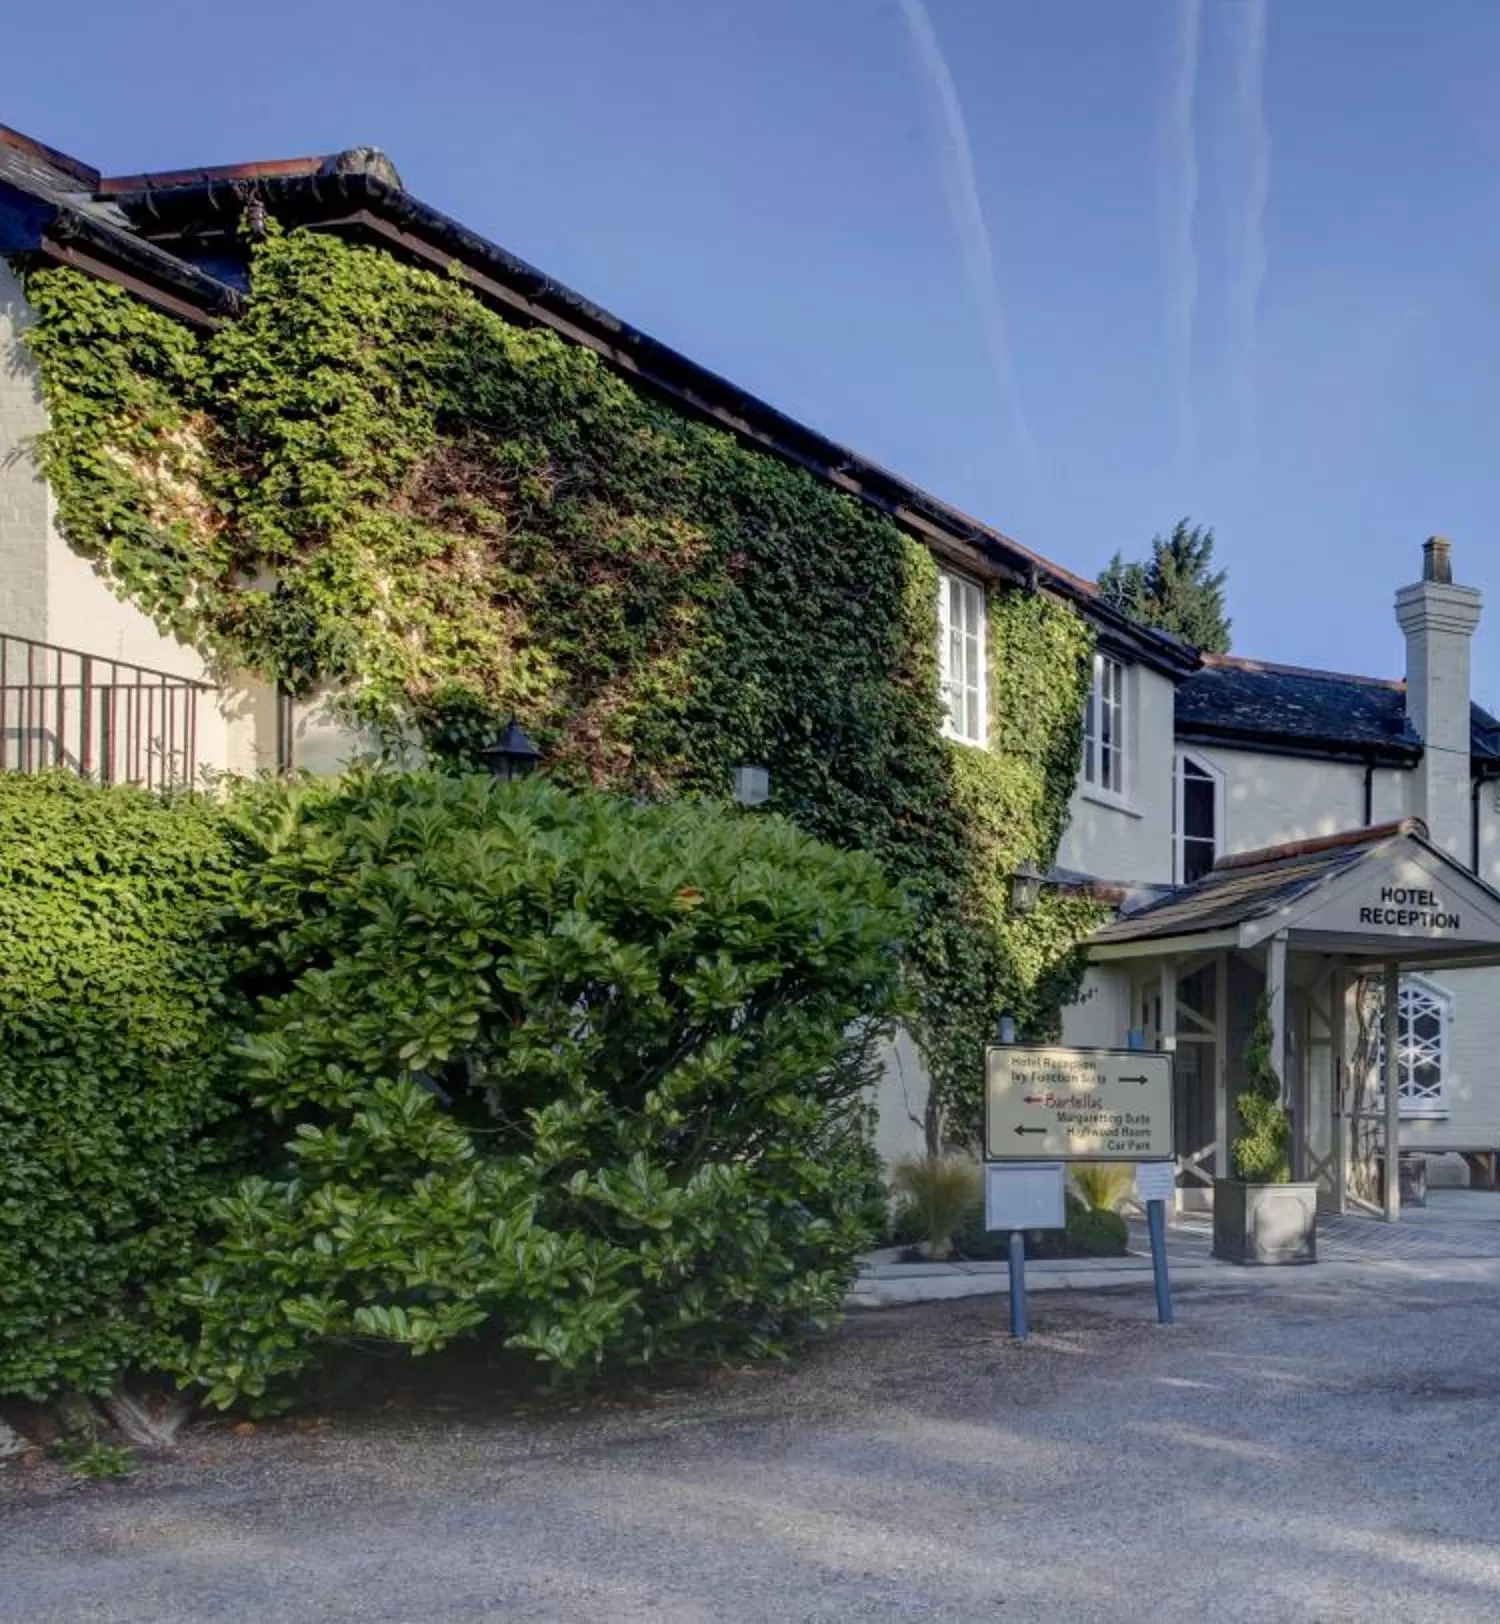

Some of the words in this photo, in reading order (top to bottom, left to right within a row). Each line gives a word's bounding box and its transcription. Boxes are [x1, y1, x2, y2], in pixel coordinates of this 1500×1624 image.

[1381, 887, 1439, 907] HOTEL
[1359, 907, 1460, 929] RECEPTION
[1107, 1140, 1124, 1151] Car
[1127, 1140, 1151, 1151] Park
